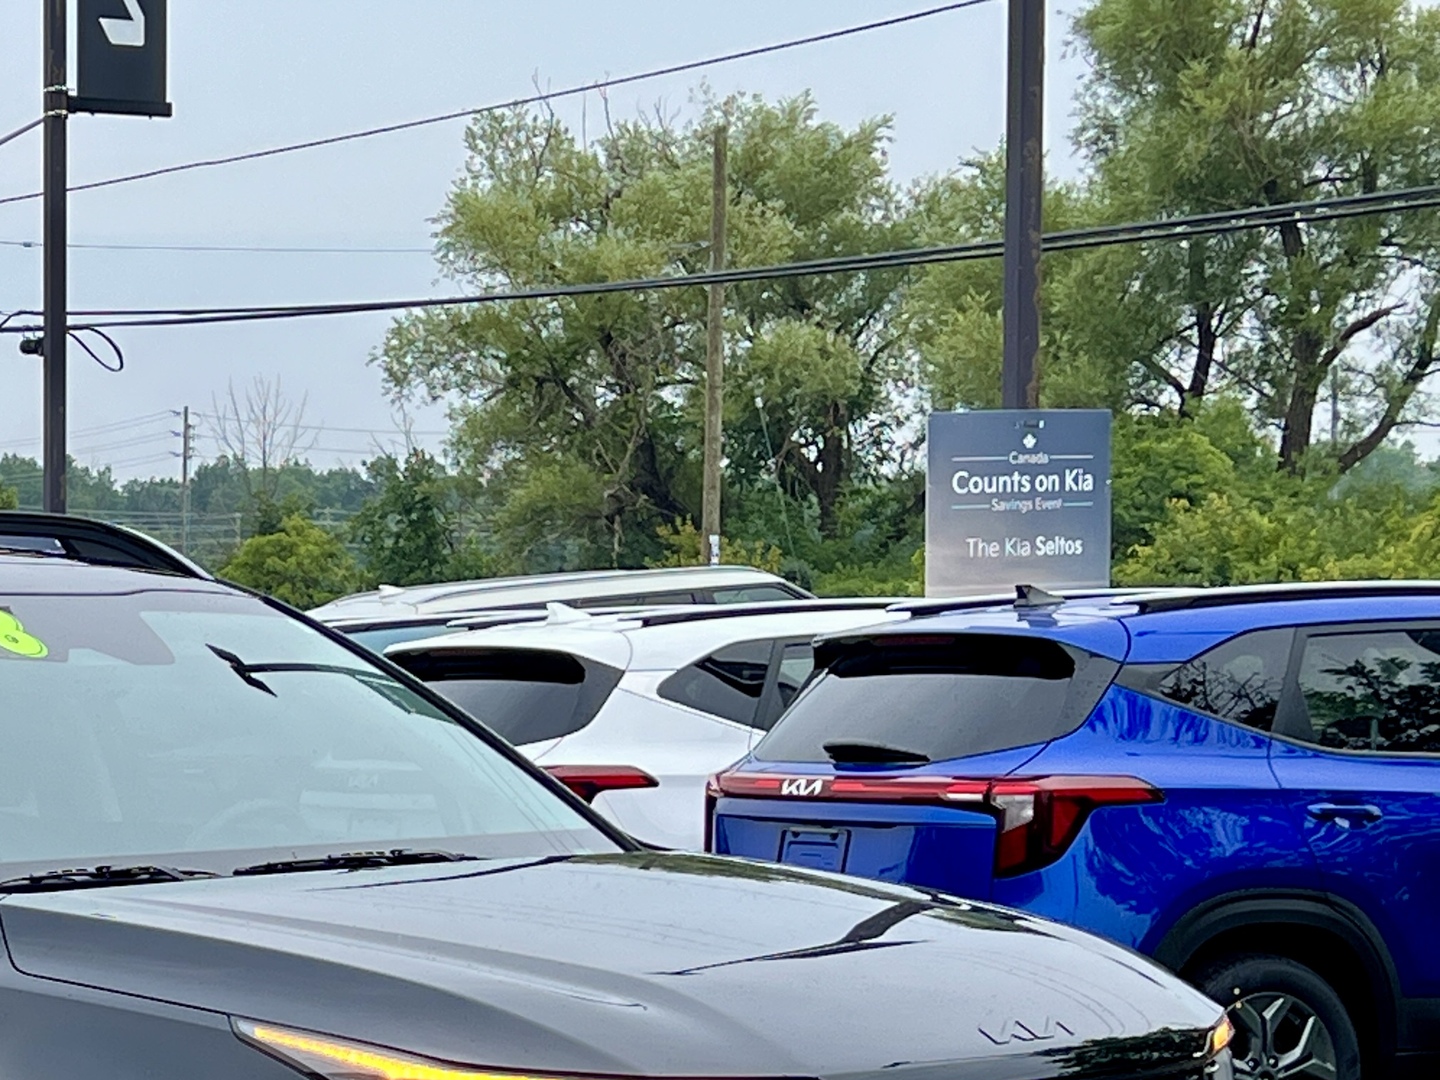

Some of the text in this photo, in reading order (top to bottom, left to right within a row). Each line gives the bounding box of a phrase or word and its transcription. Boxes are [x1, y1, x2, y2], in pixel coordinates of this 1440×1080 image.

[1009, 451, 1050, 464] Canada
[952, 468, 1094, 494] Counts on Kia
[991, 497, 1063, 513] Savings Event
[965, 535, 1084, 558] The Kia Seltos
[781, 778, 823, 796] KIA
